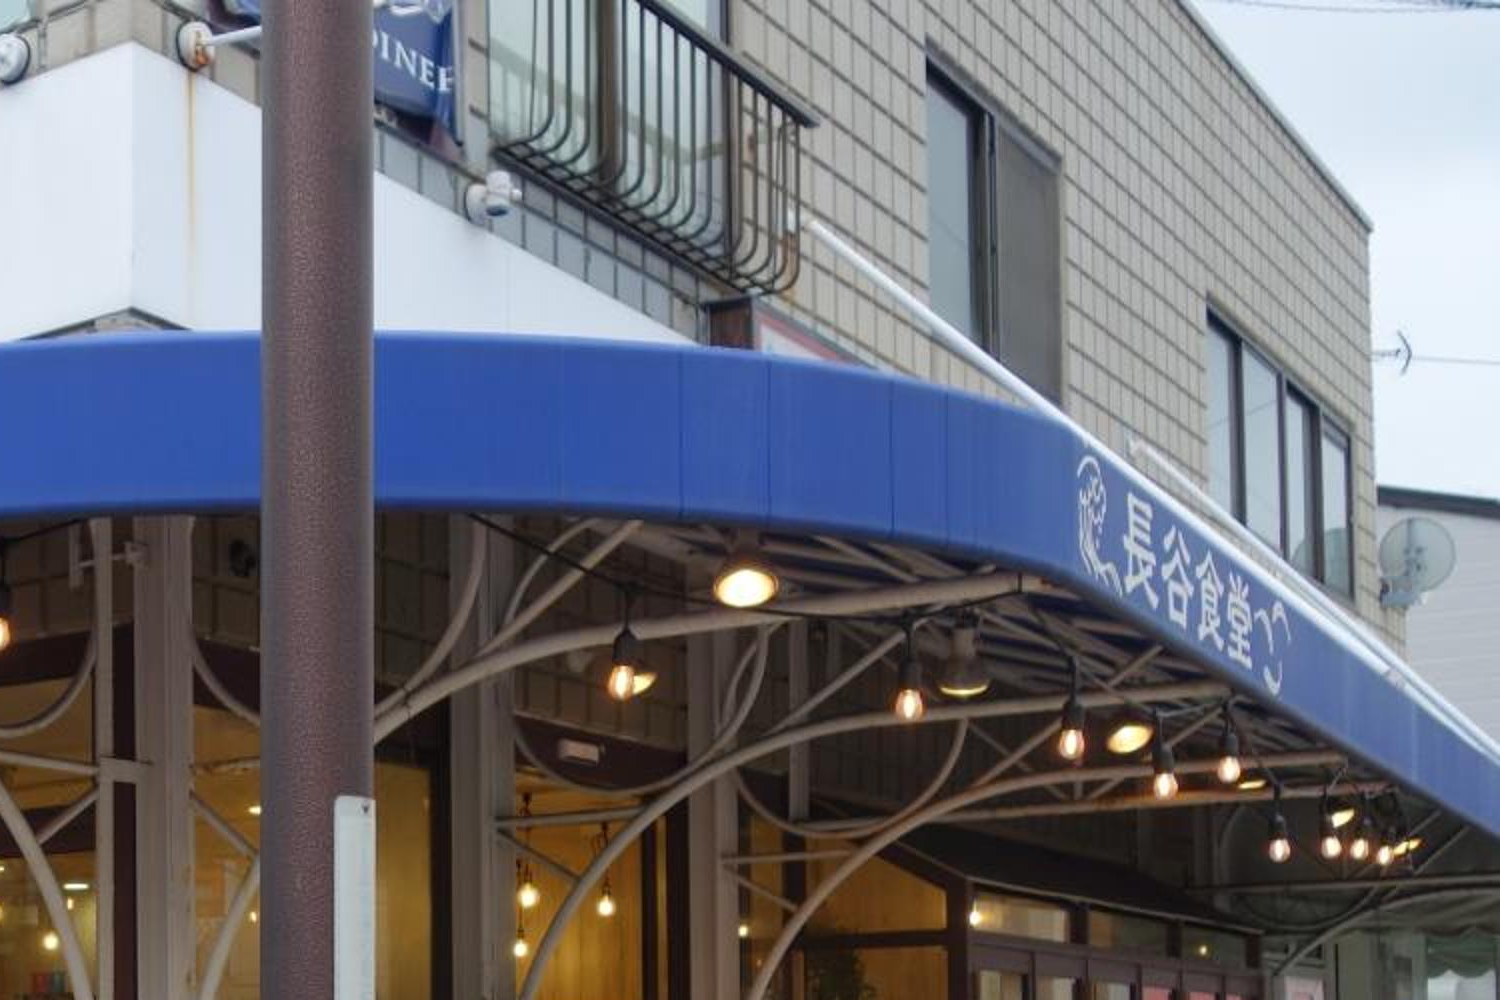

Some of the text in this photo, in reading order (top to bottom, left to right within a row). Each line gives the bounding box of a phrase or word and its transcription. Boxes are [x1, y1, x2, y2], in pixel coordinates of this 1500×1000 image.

[372, 30, 455, 93] INER
[1122, 491, 1255, 672] 長谷食堂
